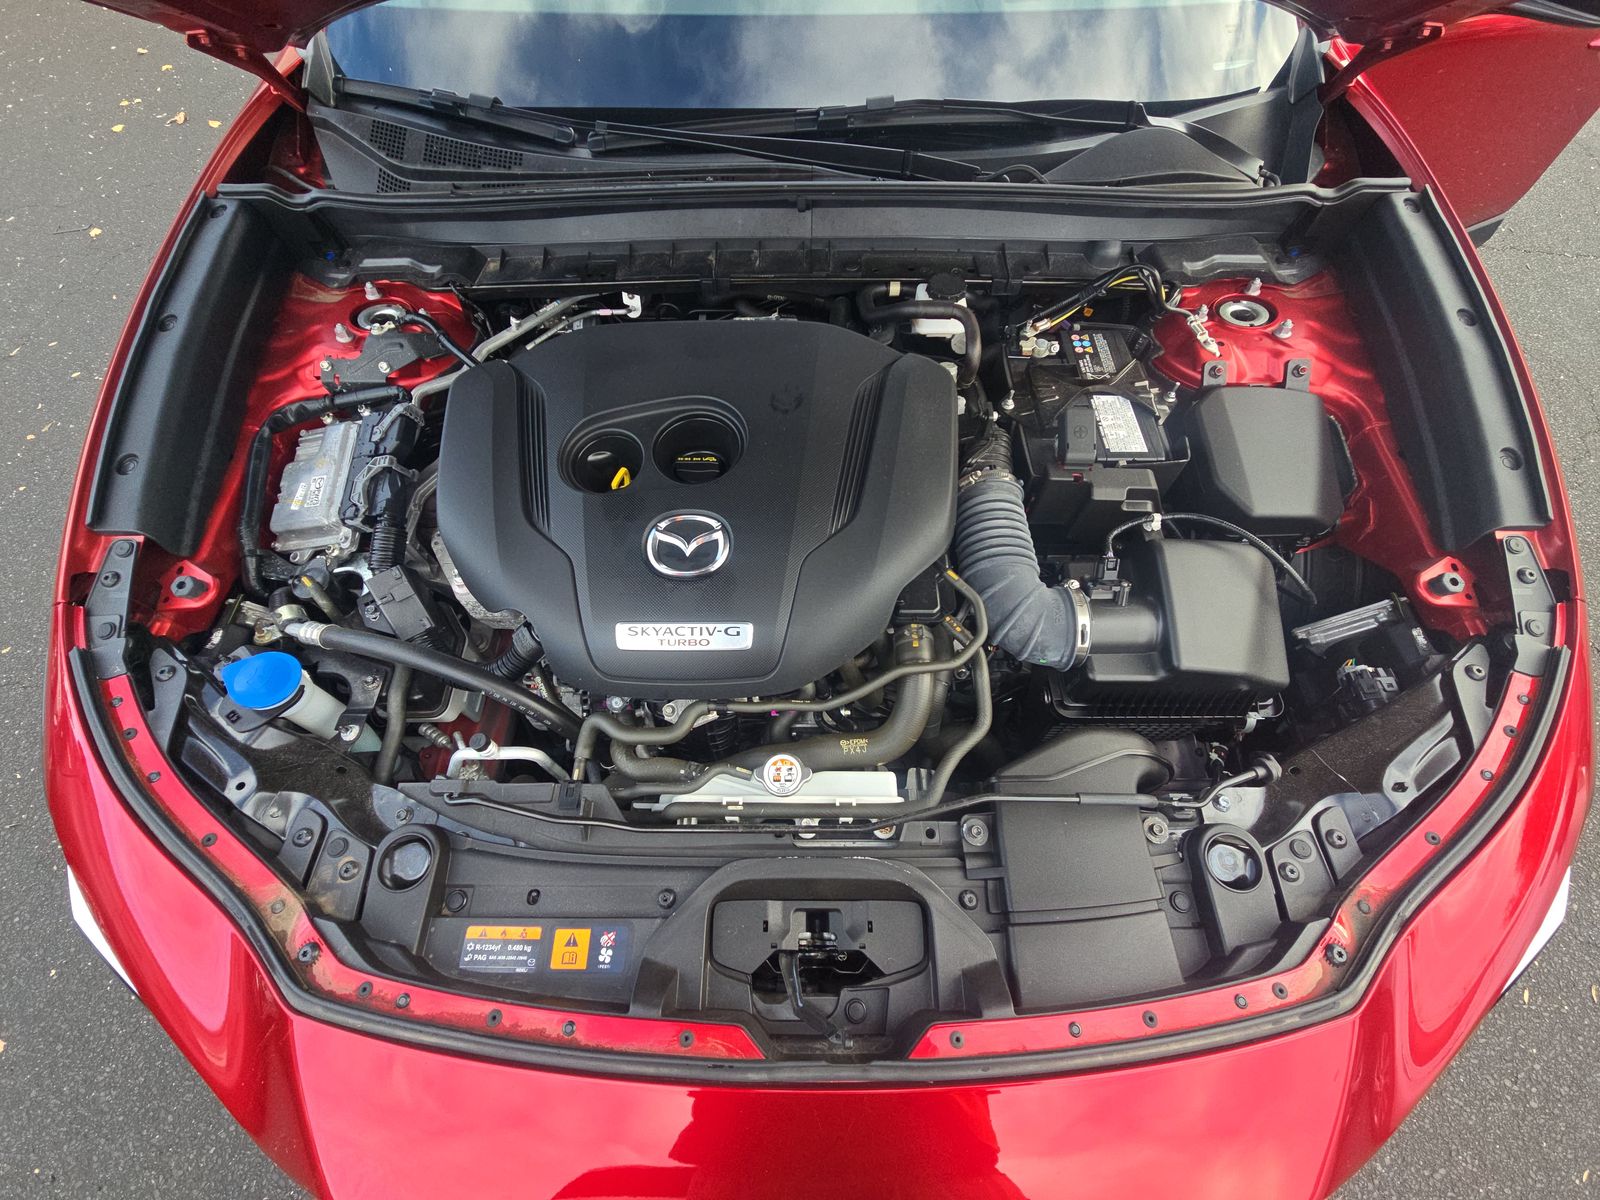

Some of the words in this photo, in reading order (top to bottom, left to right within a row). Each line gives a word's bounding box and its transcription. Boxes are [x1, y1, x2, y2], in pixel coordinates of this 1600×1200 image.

[627, 626, 741, 637] SKYACTIV-G
[657, 639, 711, 647] TURBO
[475, 944, 502, 952] R-1234yf
[524, 944, 532, 953] kg
